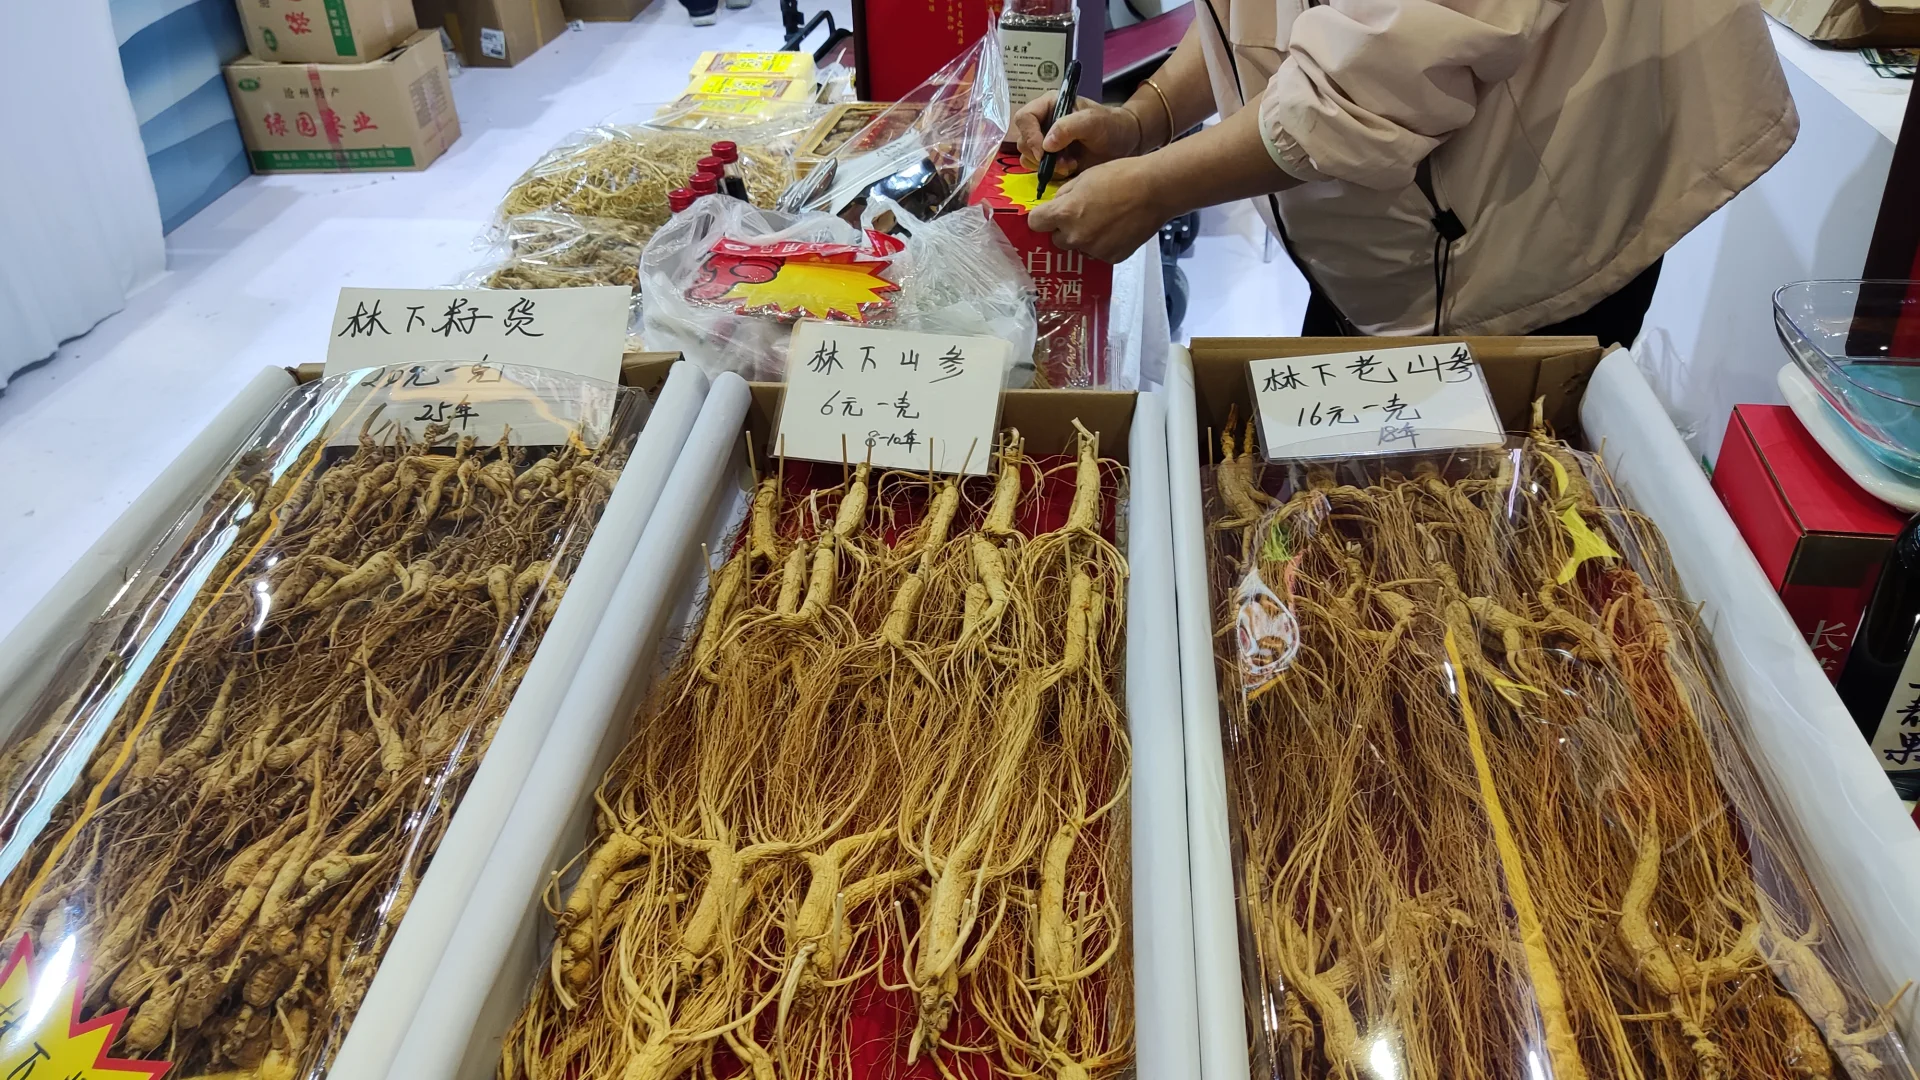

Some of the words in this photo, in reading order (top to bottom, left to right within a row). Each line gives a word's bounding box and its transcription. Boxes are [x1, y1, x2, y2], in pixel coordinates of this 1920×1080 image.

[1016, 246, 1083, 275] 白山
[807, 340, 965, 384] 林下山参
[1262, 346, 1475, 393] 林下老山参
[820, 390, 920, 419] 6元一克
[1297, 393, 1422, 427] 16元一克
[1377, 422, 1420, 449] 18年
